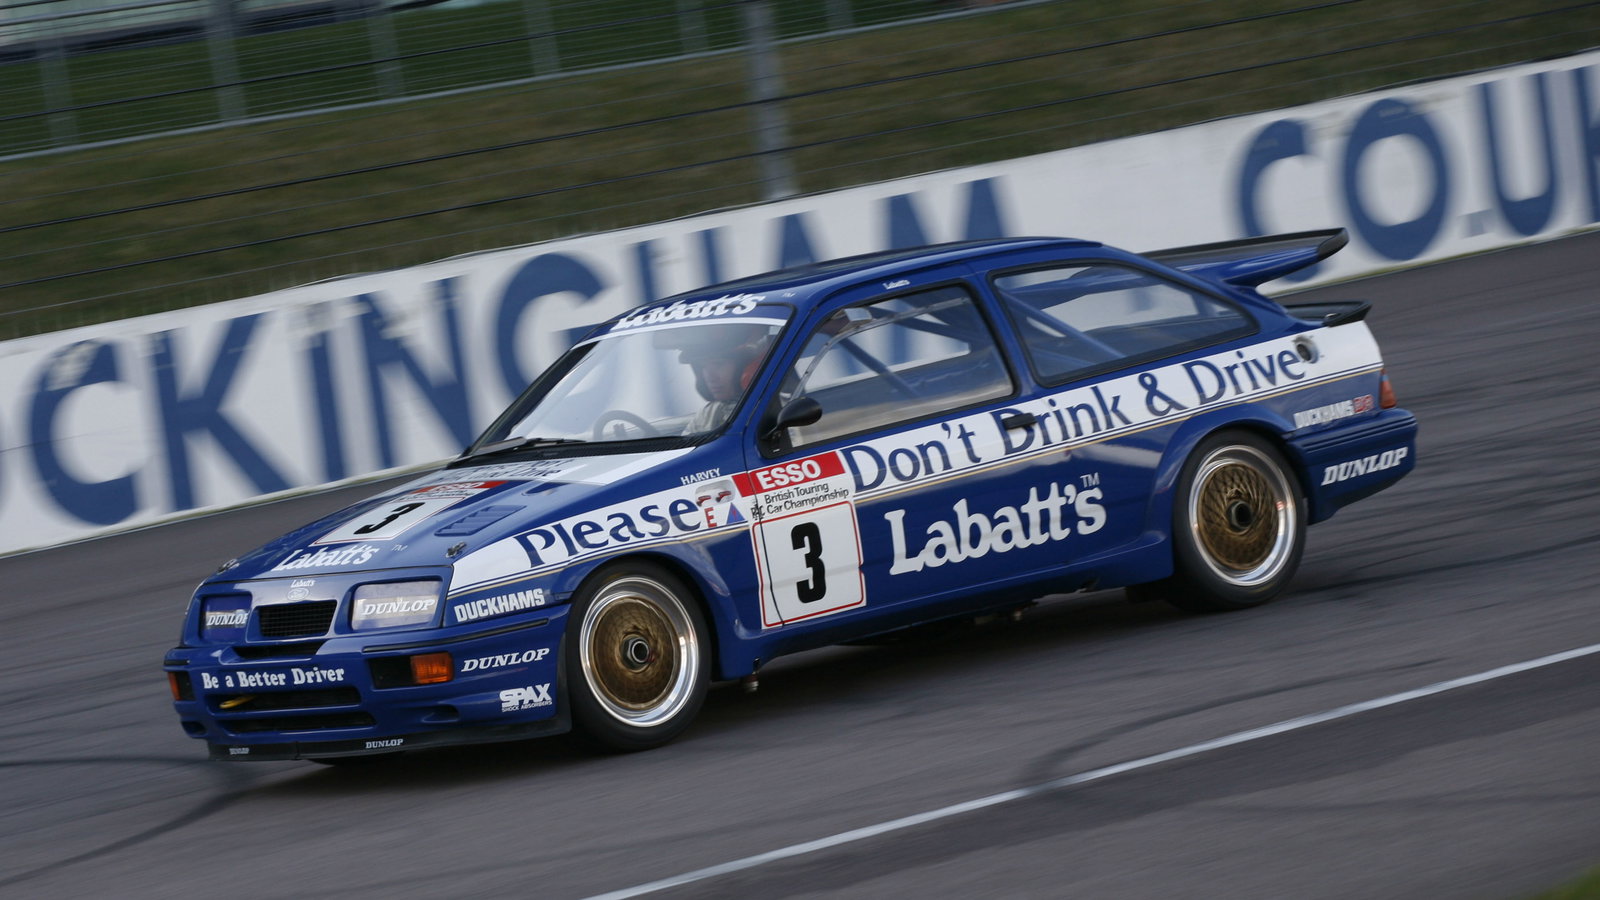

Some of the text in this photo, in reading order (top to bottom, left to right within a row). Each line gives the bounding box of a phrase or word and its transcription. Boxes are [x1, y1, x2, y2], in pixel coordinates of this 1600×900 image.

[609, 293, 766, 332] Labatt's
[513, 349, 1305, 569] Please Don't Drink & Drive
[1320, 446, 1409, 486] DUNLOP
[681, 467, 720, 485] HARVEY
[756, 459, 821, 489] ESSO
[1080, 473, 1100, 487] TM
[764, 482, 829, 504] British Touring
[766, 487, 849, 515] Car Championship
[353, 502, 426, 535] 3
[884, 481, 1107, 576] Labatt's
[271, 543, 380, 572] Labatt's
[790, 521, 828, 603] 3
[360, 598, 435, 616] DUNLOP
[454, 588, 546, 622] DUCKHAMS
[461, 647, 550, 672] DUNLOP
[201, 667, 345, 689] Be a Better Driver
[499, 683, 552, 708] SPAX
[365, 738, 403, 749] DUNLOP
